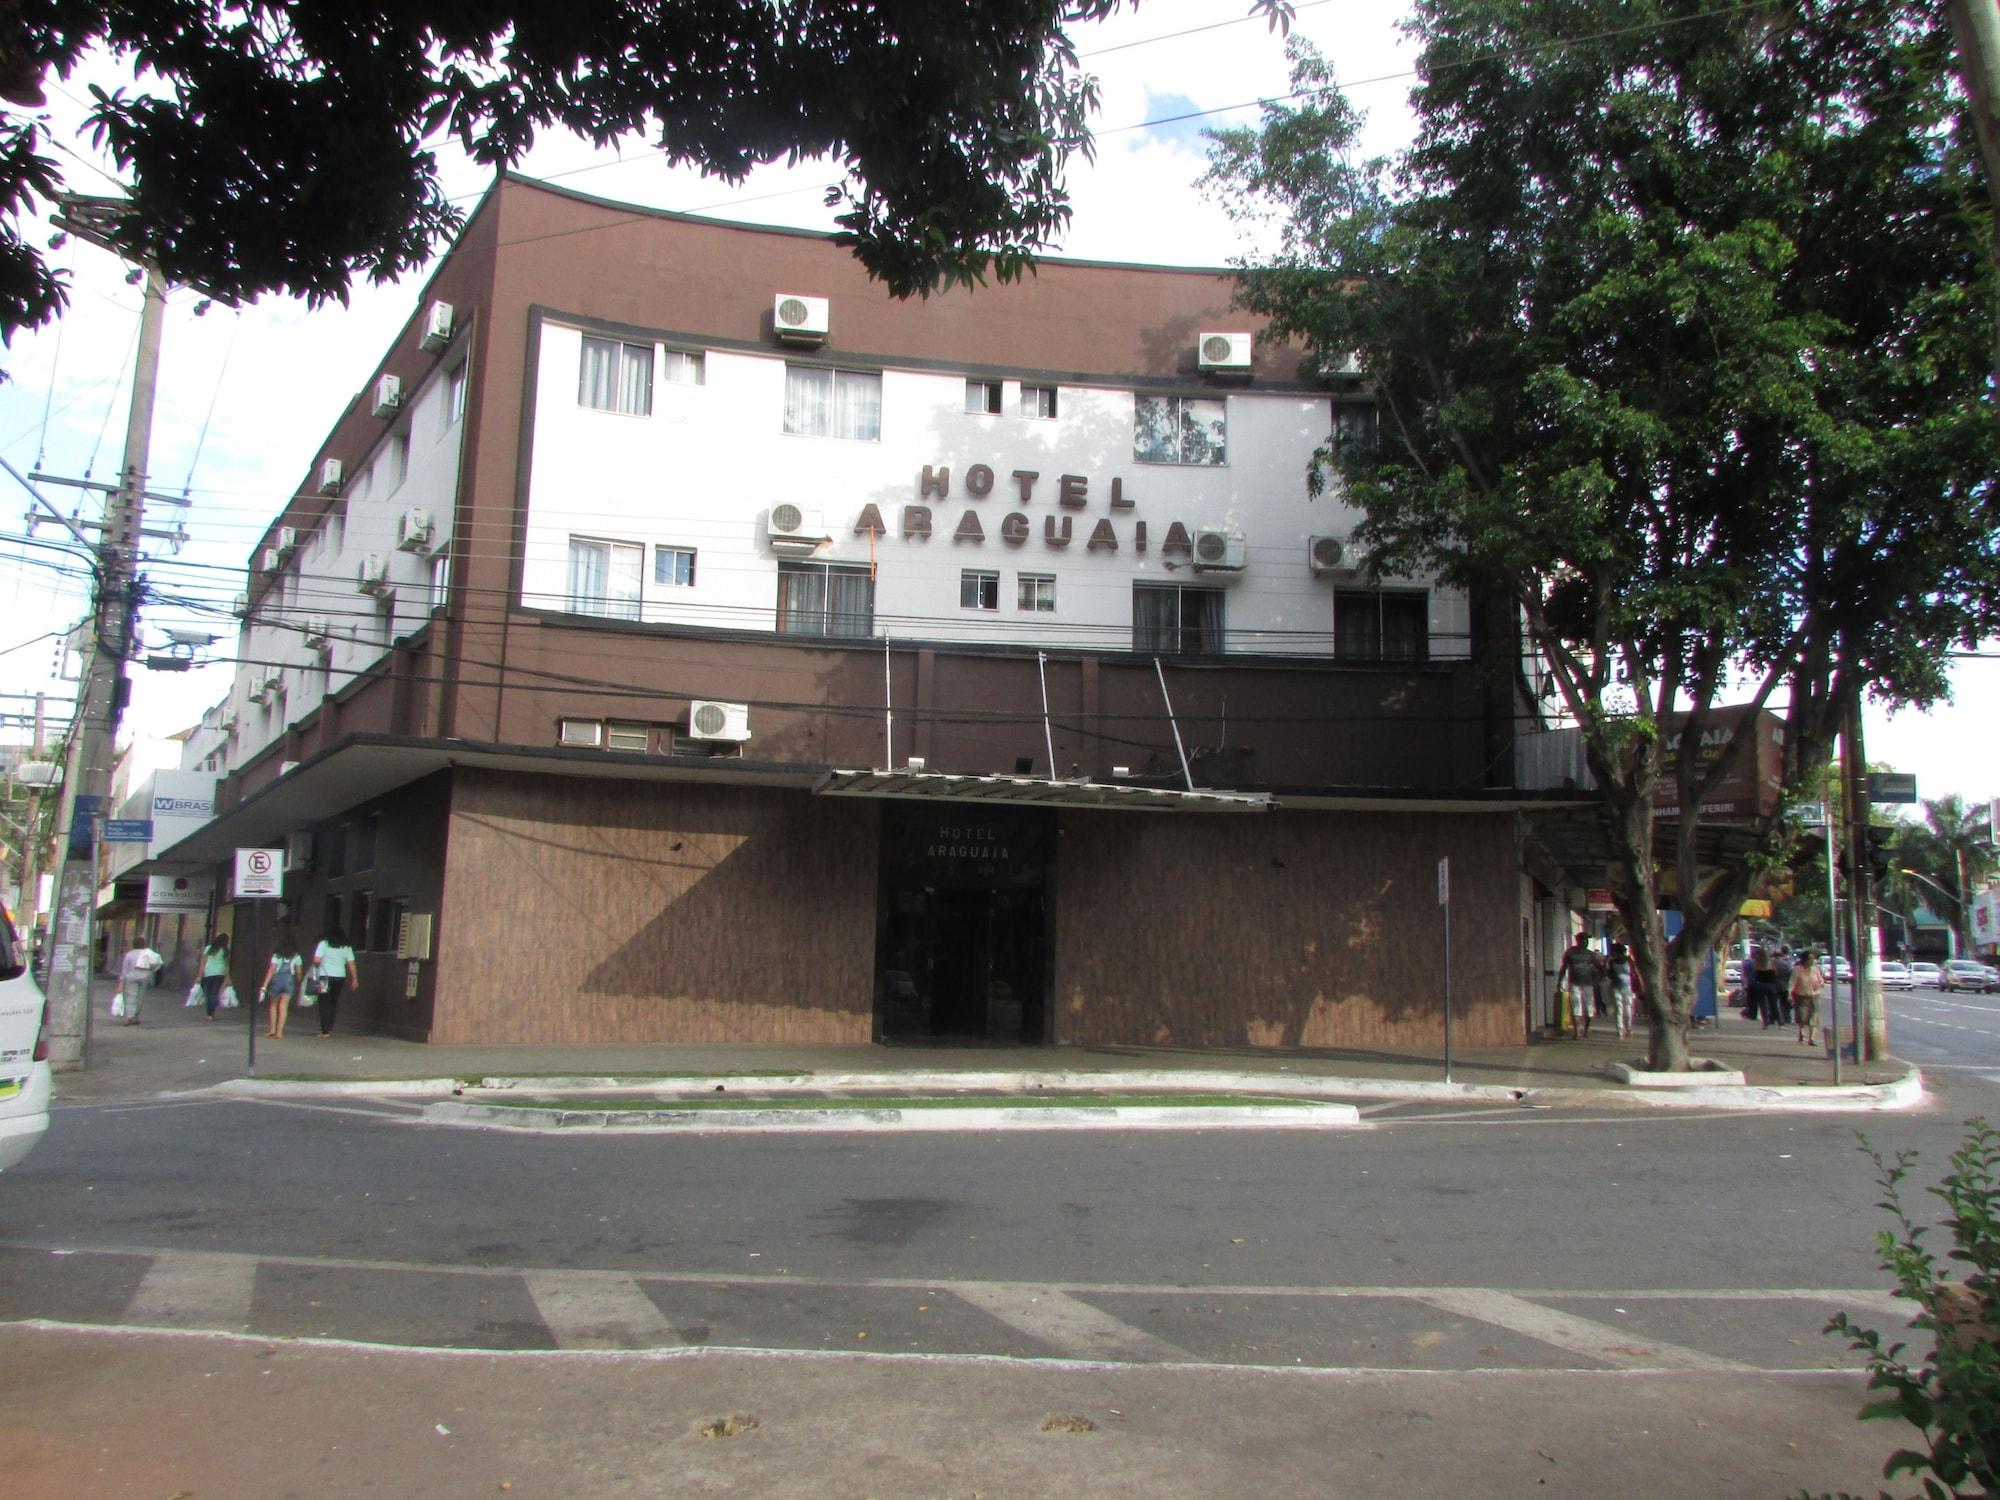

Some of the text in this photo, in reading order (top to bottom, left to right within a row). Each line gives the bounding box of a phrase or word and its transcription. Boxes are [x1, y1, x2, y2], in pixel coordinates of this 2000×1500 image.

[921, 463, 1135, 509] HOTEL
[854, 503, 1192, 552] ARAGUAIA
[940, 826, 996, 840] HOTEL
[928, 845, 1009, 859] ARAGUAIA
